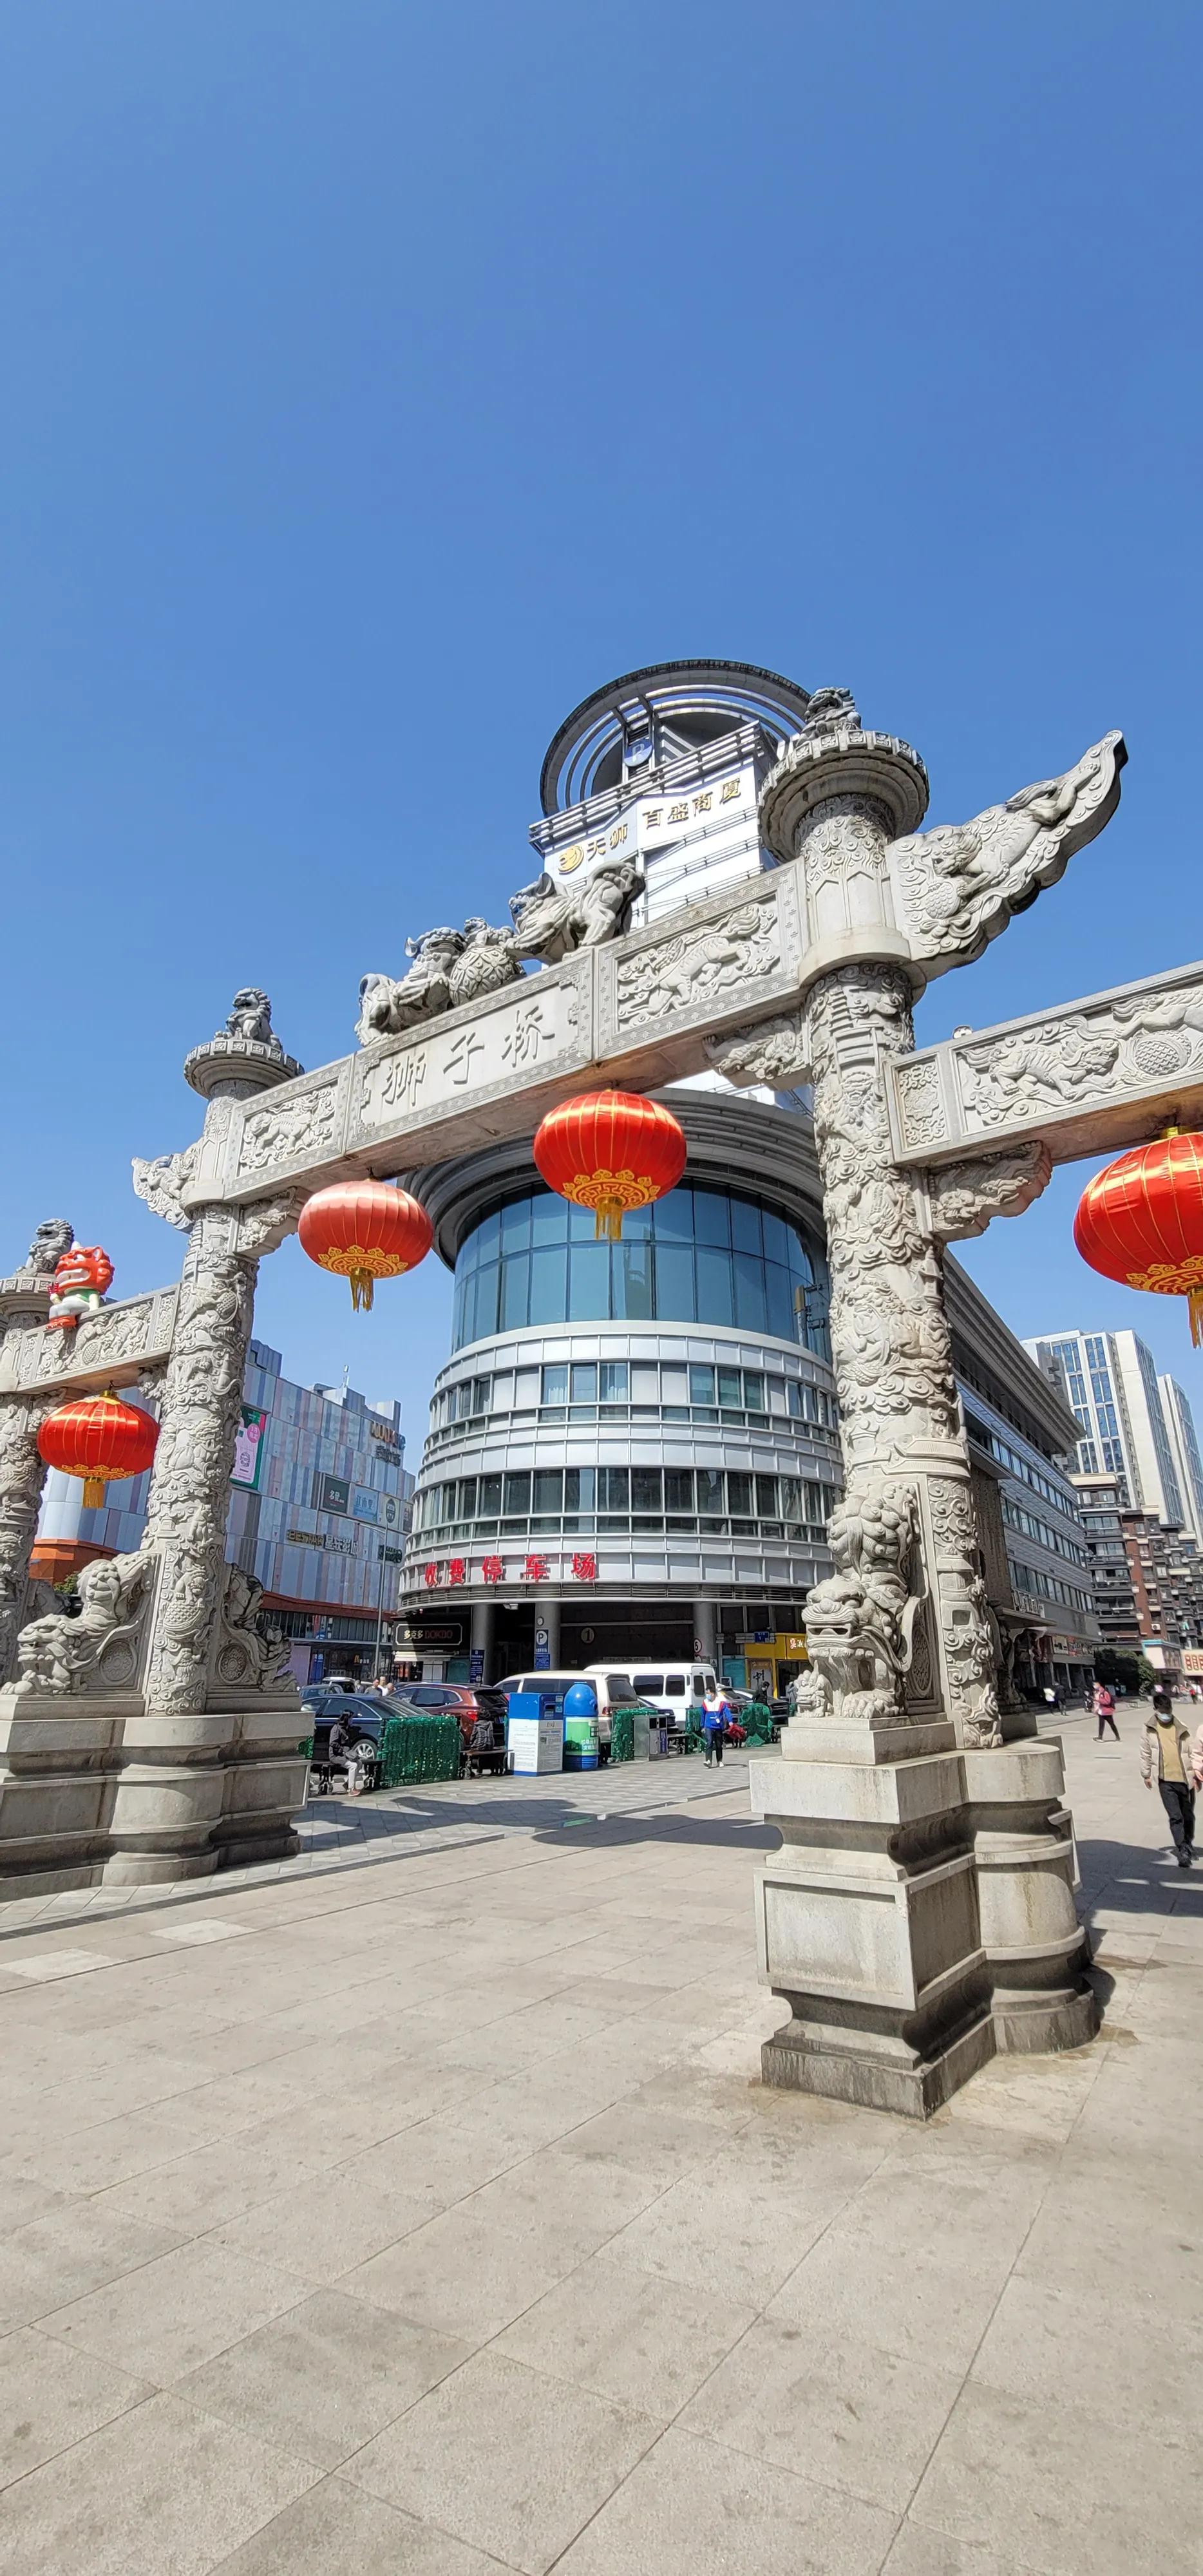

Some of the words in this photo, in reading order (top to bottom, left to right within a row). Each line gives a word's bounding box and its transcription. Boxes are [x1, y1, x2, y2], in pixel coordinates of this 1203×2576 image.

[587, 822, 629, 860] 天狮
[642, 778, 742, 829] 百盛商厦
[381, 1006, 555, 1107] 狮子桥
[424, 1552, 597, 1587] 收费停车场
